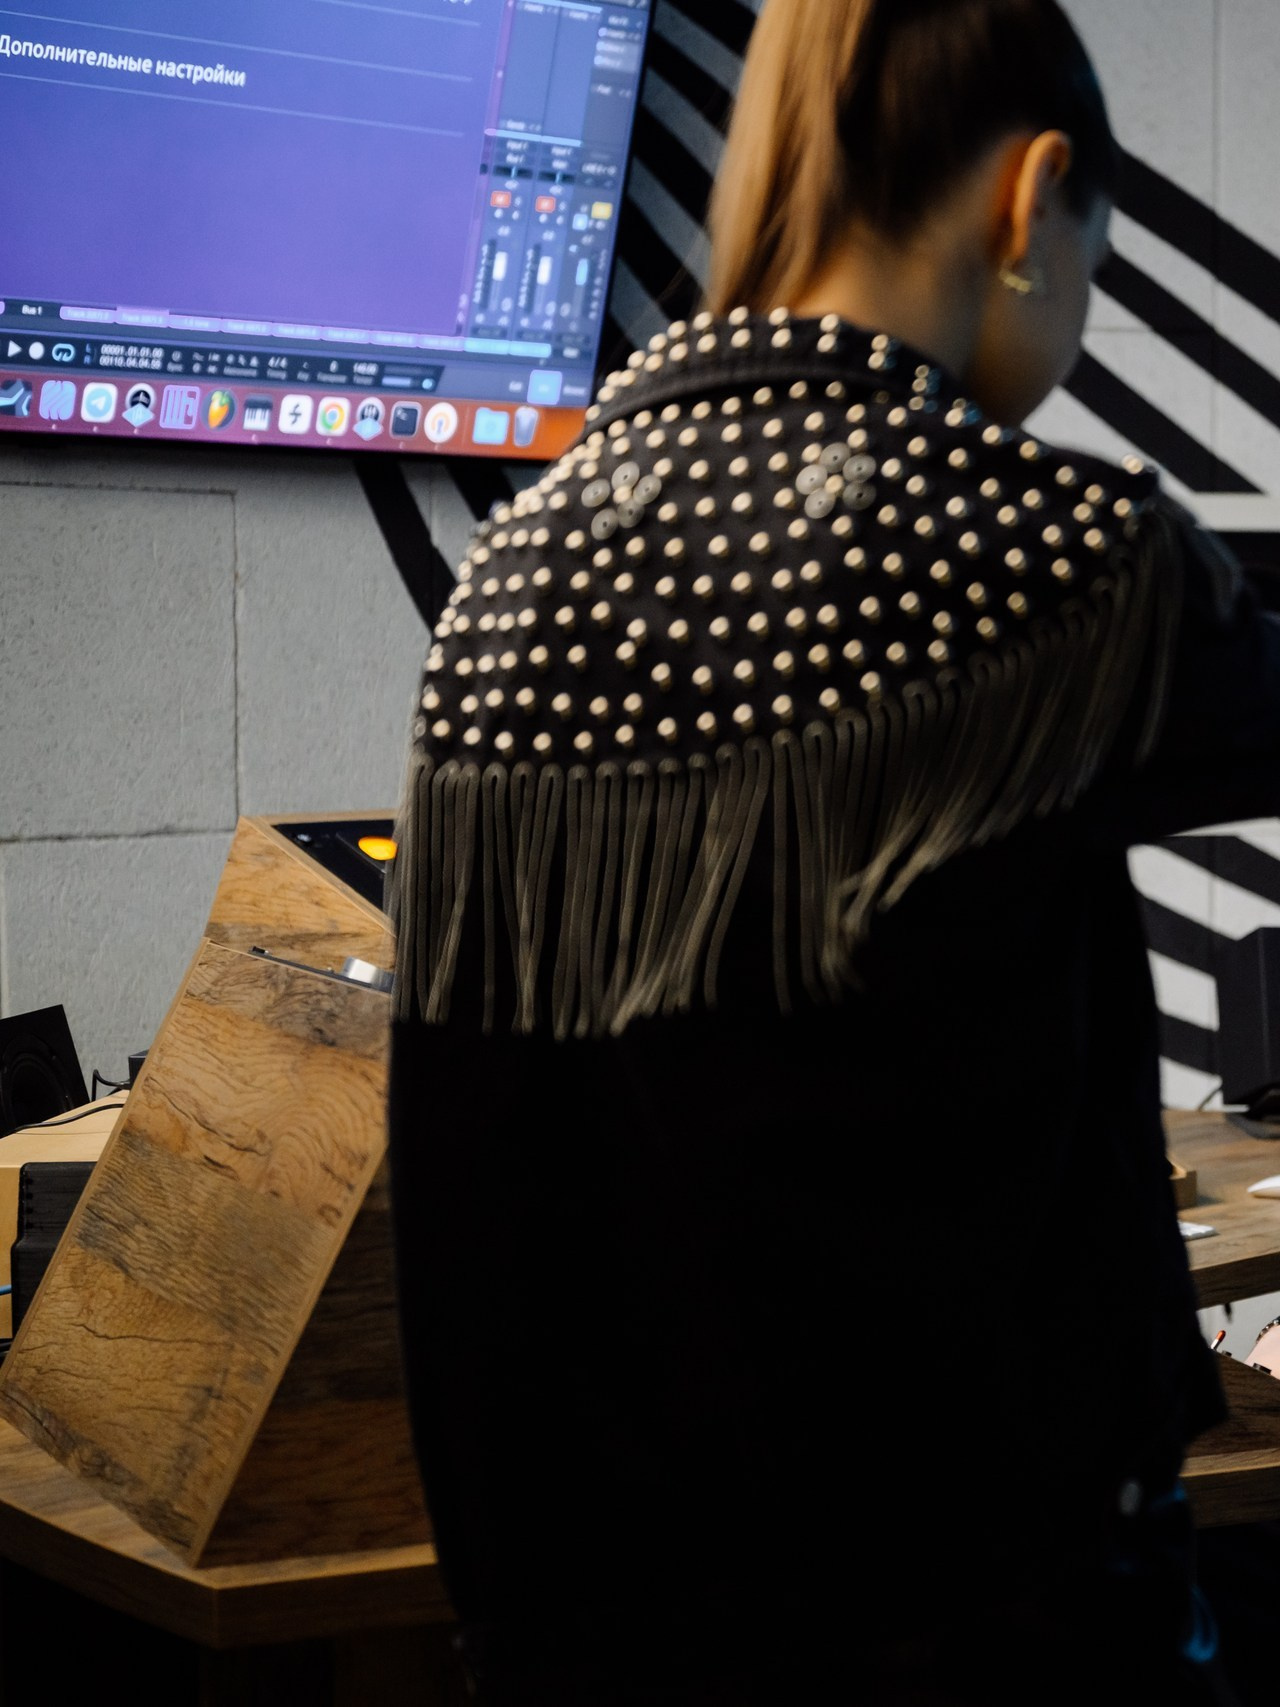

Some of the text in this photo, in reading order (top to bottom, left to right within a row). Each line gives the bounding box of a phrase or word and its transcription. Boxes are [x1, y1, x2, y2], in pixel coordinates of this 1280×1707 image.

[0, 34, 247, 87] Дополнительные настройки
[21, 304, 37, 316] Bus
